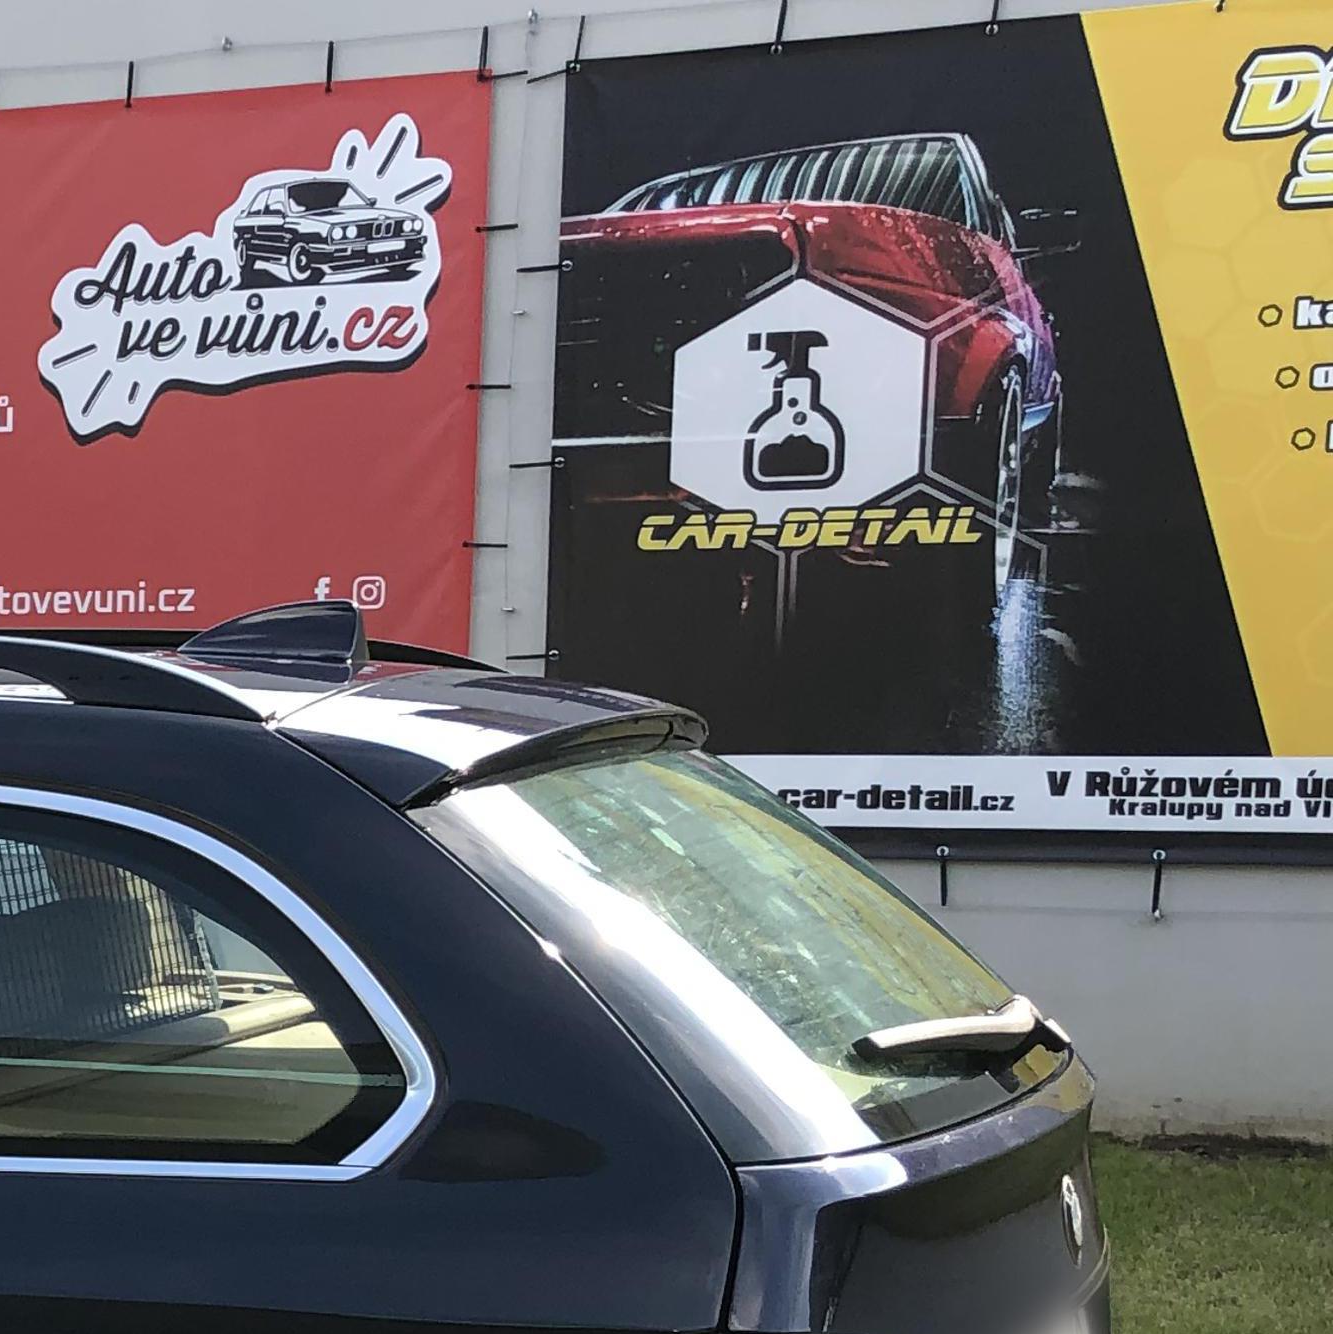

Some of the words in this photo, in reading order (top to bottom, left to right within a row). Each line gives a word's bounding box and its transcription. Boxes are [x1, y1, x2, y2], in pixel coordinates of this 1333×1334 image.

[73, 241, 231, 316] Auto
[117, 315, 187, 362] ve
[636, 506, 985, 551] CAR-DETAIL
[778, 784, 1015, 811] car-detail.cz
[1046, 770, 1072, 797] V
[1085, 766, 1281, 798] Růžovém
[1109, 799, 1223, 820] Kralupy
[1235, 799, 1291, 818] nad
